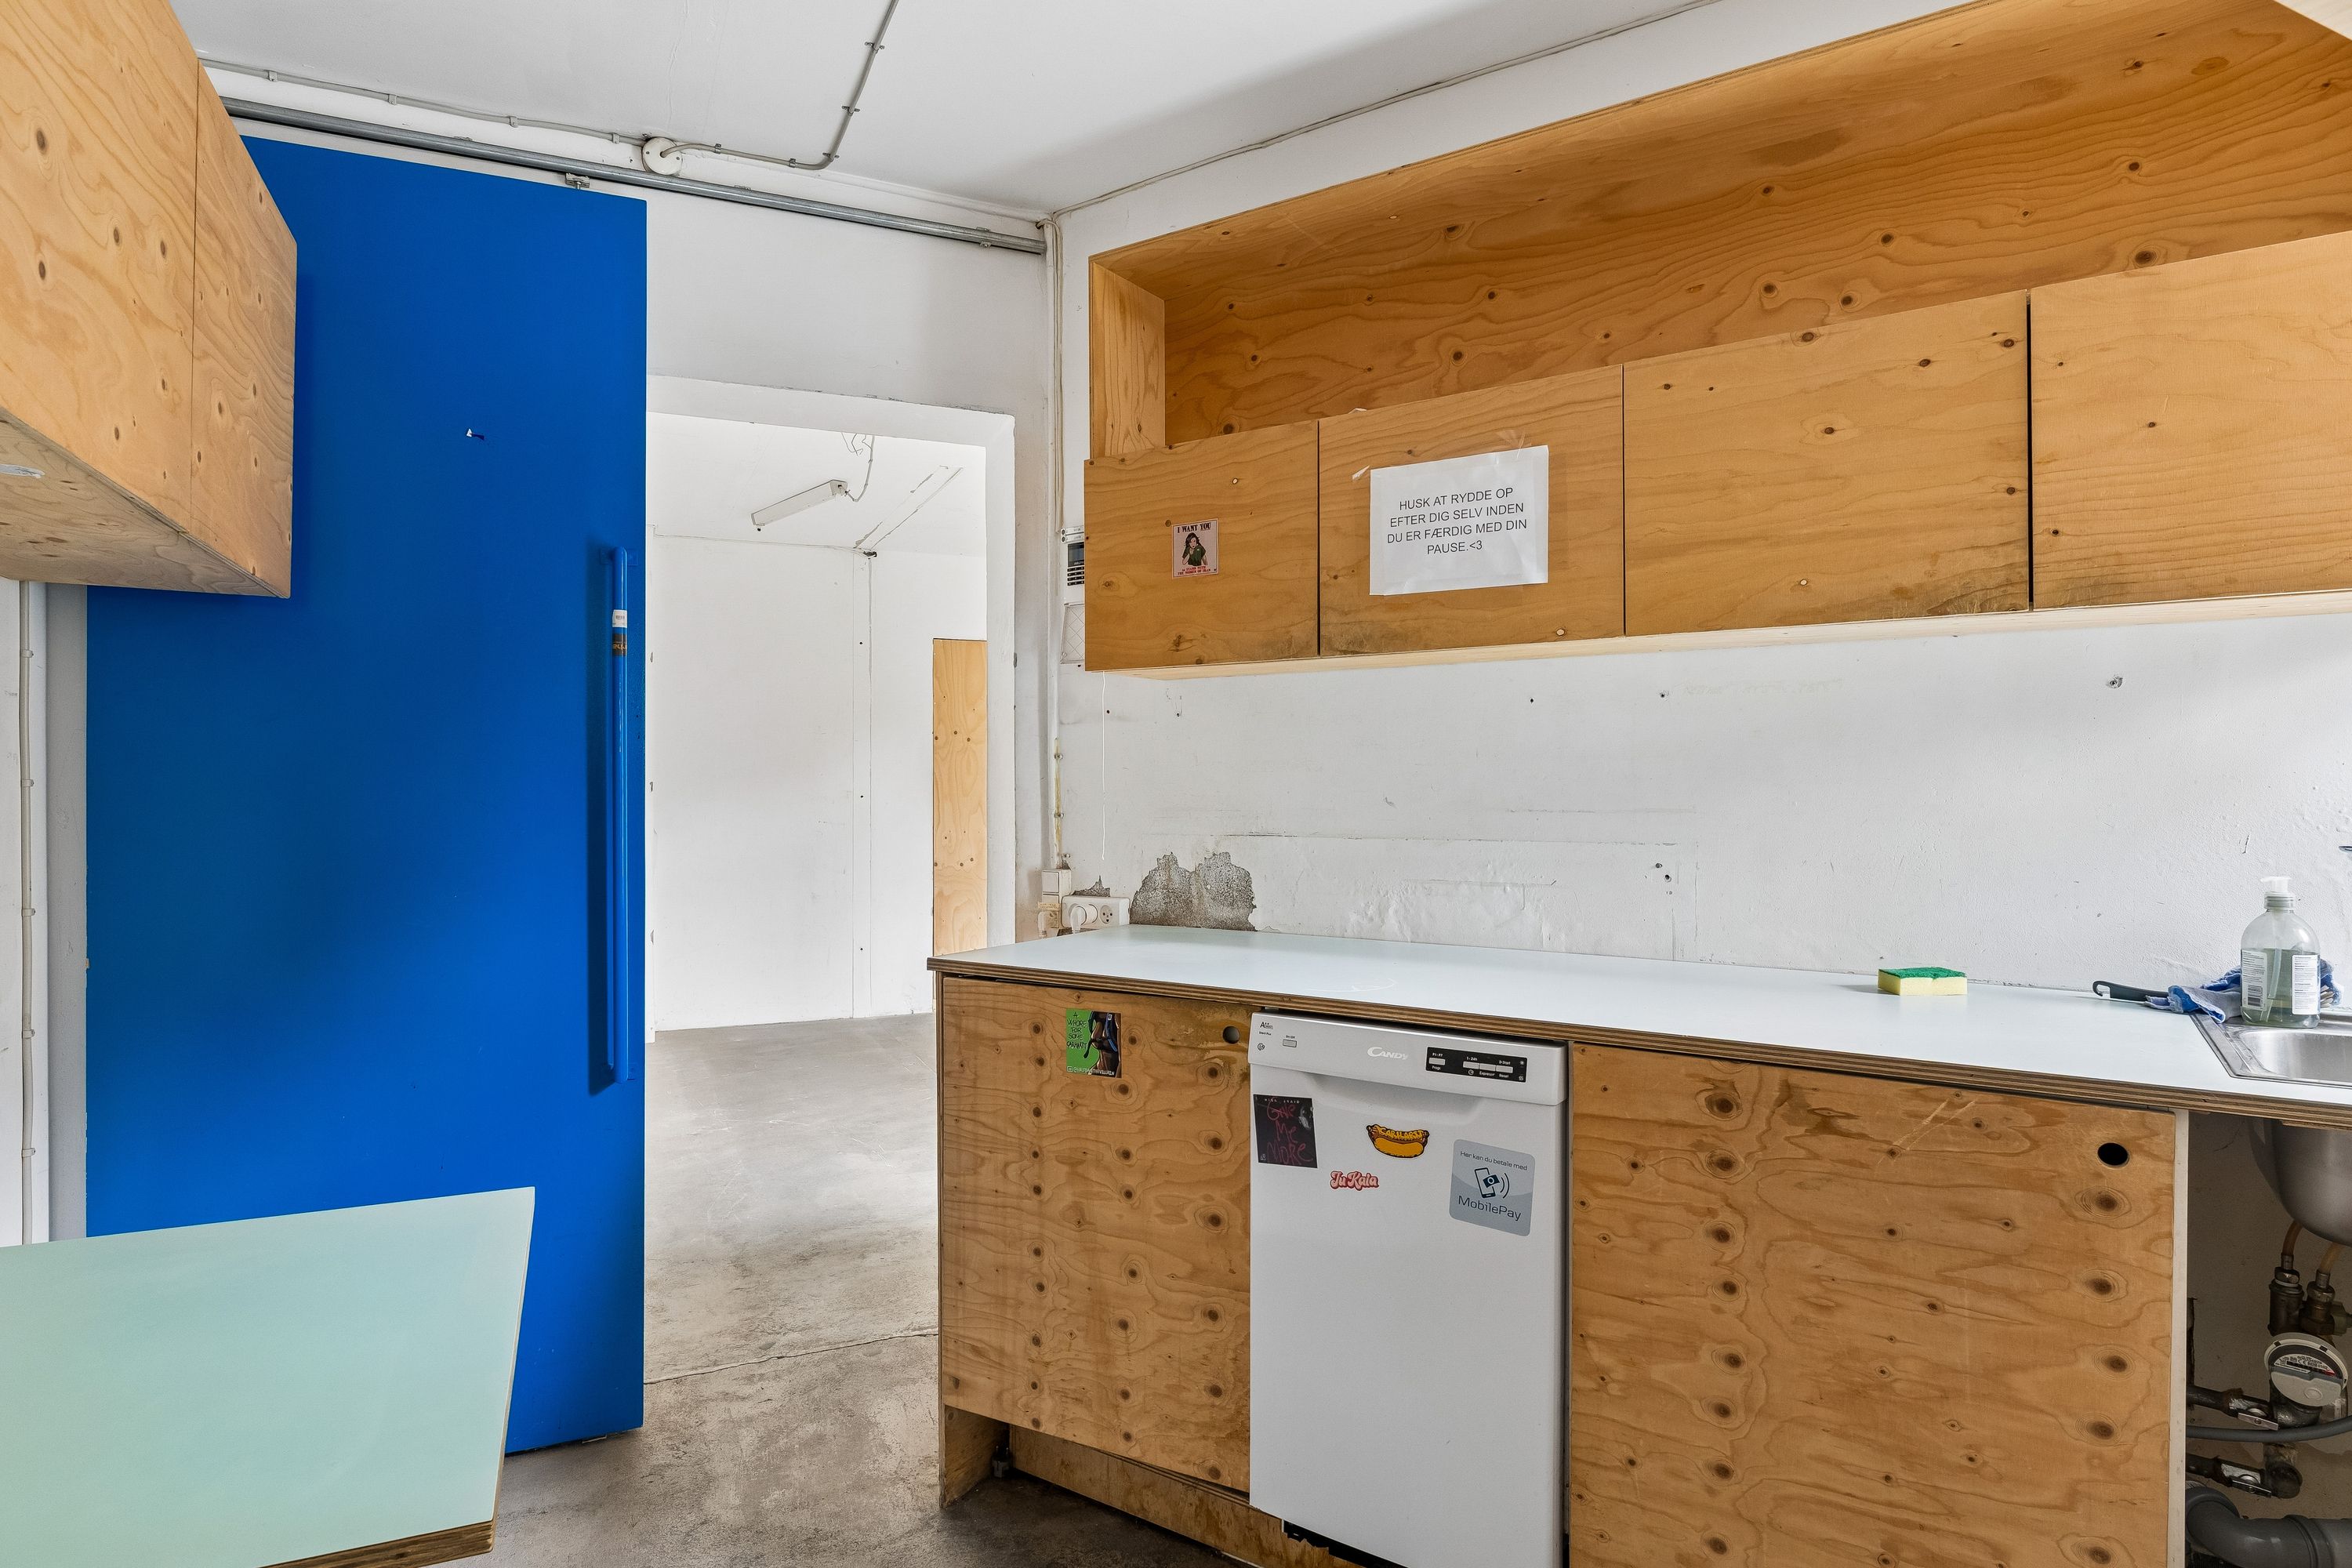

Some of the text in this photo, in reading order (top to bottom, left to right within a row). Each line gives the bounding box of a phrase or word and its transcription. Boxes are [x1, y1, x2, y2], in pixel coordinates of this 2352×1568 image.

[1399, 488, 1513, 510] HUSK AT RYDDE OP
[1200, 522, 1211, 531] YOU
[1390, 503, 1524, 528] EFTER DIG SELV INDEN
[1388, 519, 1527, 544] DU ER FÆRDIG MED DIN
[1367, 1046, 1409, 1060] CANDY
[1493, 1158, 1512, 1167] betale
[1458, 1195, 1522, 1221] MobilePay
